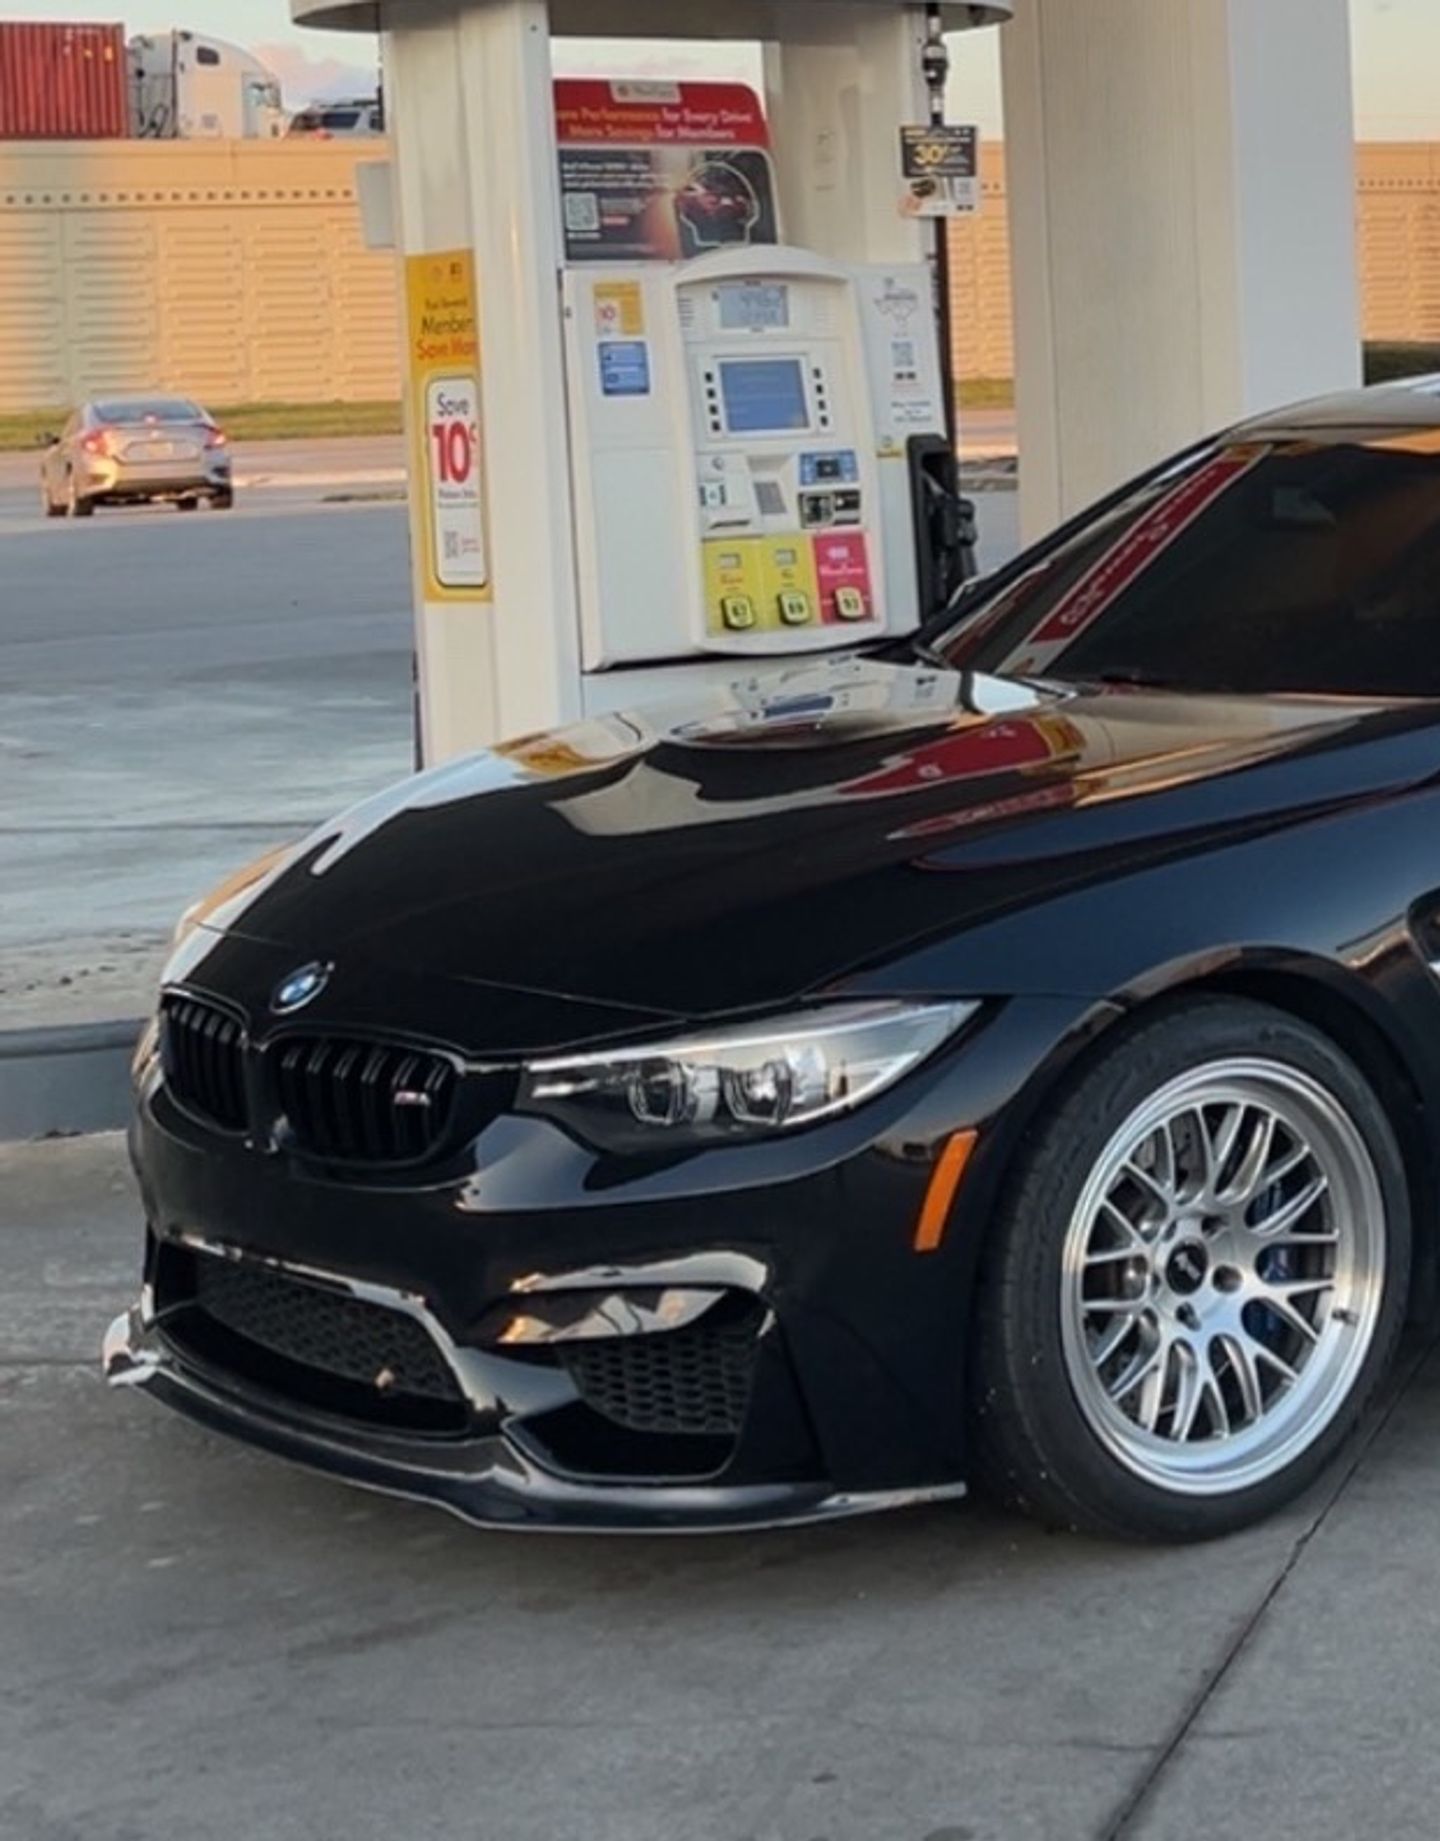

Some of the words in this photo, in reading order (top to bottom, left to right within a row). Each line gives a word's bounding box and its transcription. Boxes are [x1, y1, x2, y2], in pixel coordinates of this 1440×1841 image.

[581, 106, 661, 122] Performance
[662, 106, 680, 122] for
[682, 108, 717, 125] Every
[655, 123, 674, 138] for
[437, 391, 469, 417] Save
